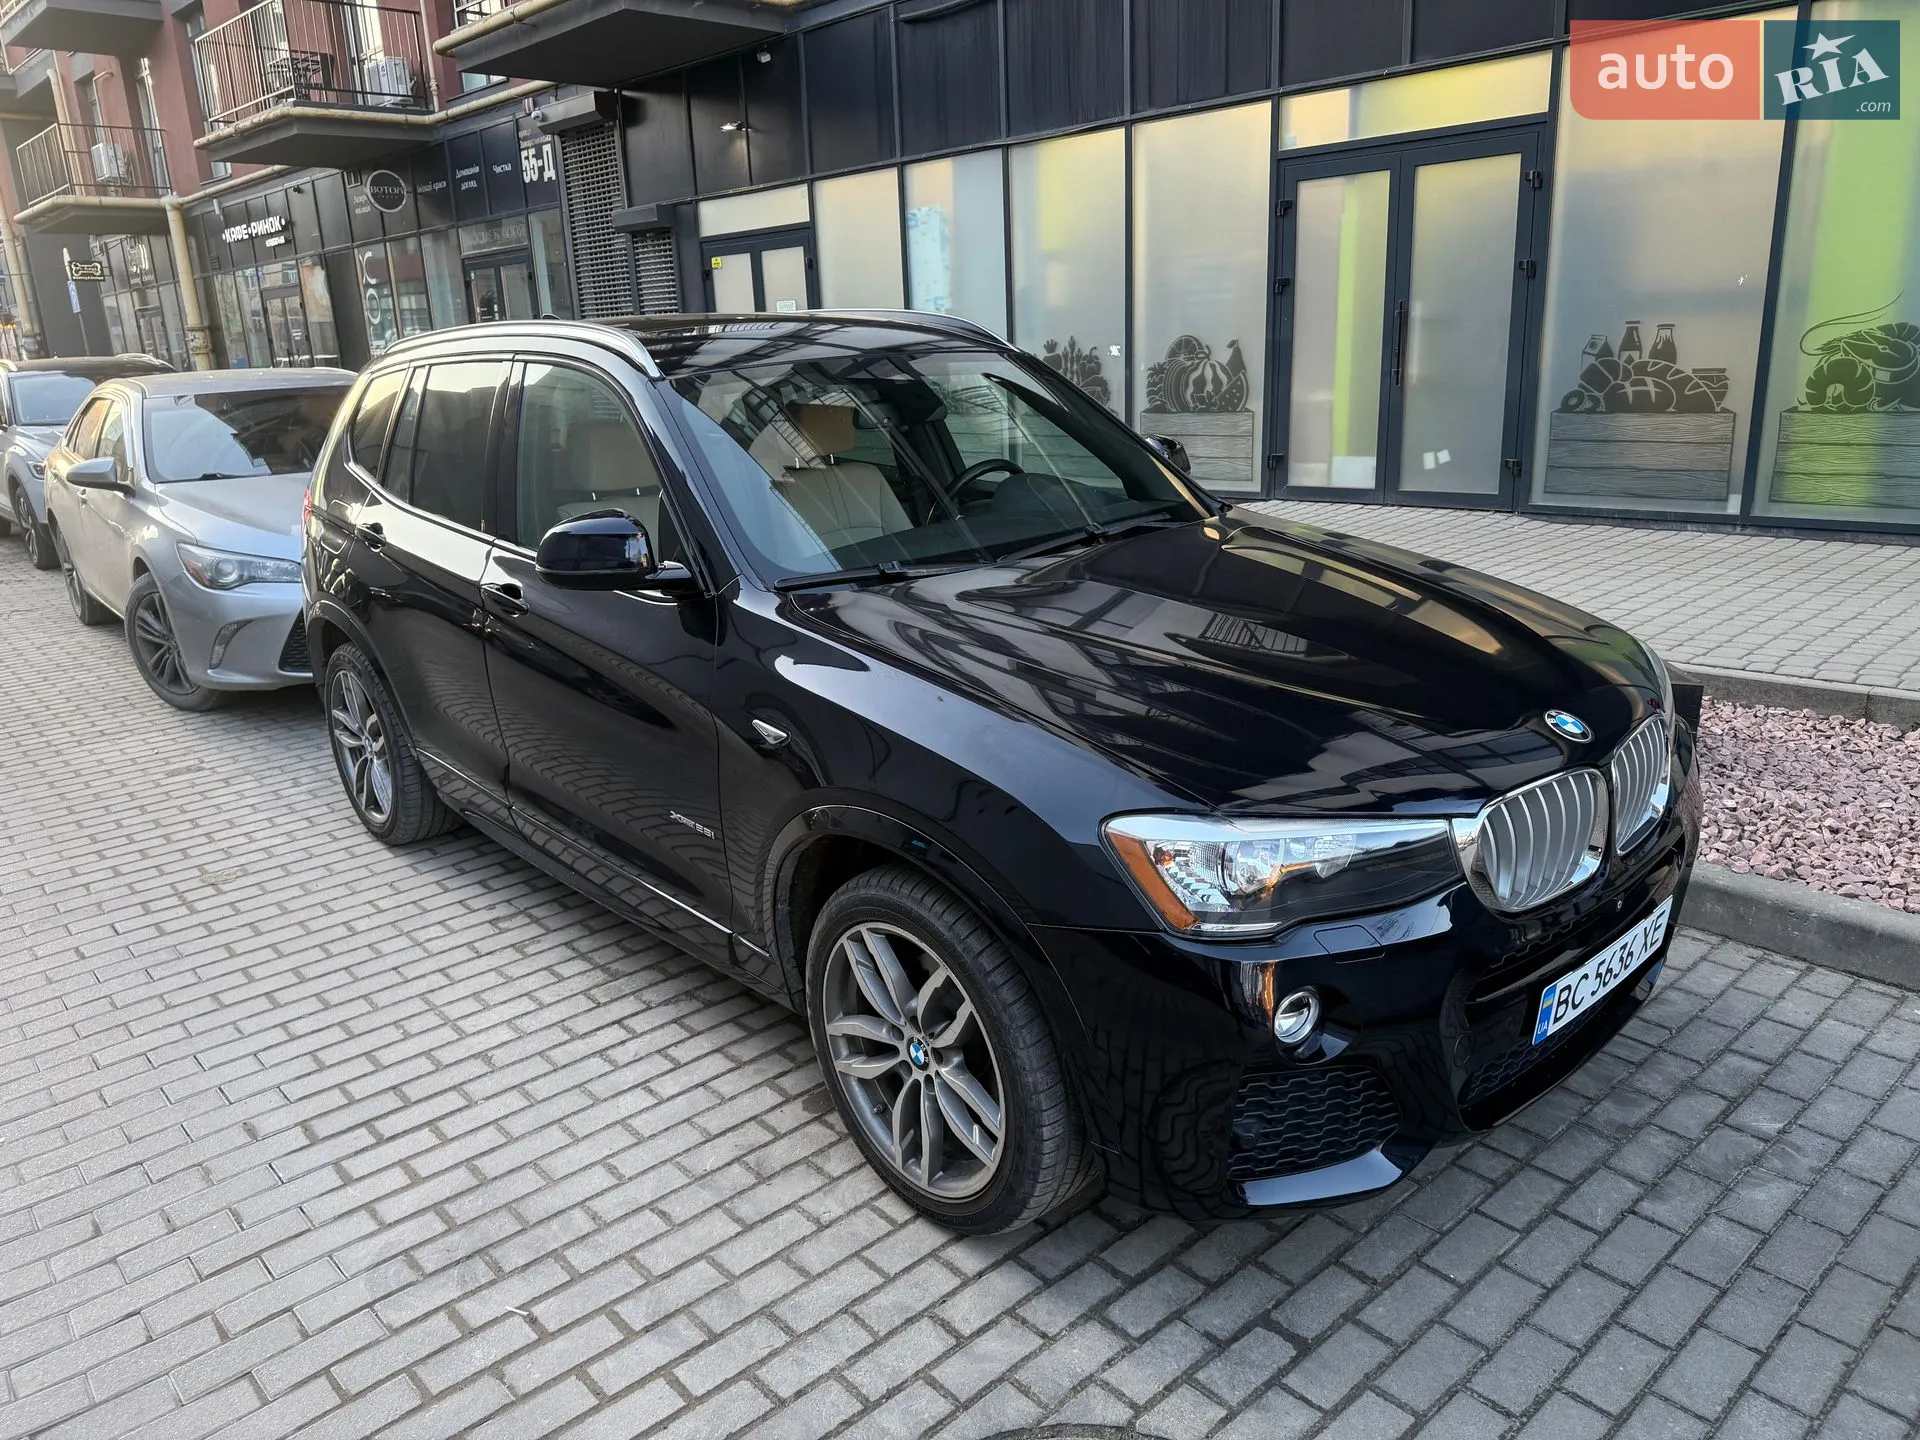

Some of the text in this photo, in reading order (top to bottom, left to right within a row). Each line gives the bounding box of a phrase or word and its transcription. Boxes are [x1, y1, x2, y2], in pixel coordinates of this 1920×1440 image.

[492, 163, 512, 174] Чистка
[521, 144, 556, 183] 55-Д
[224, 224, 249, 243] КАФЕ
[250, 215, 282, 237] РИНОК
[1552, 909, 1666, 1025] BC 5636 XE
[1537, 1020, 1548, 1034] UA
